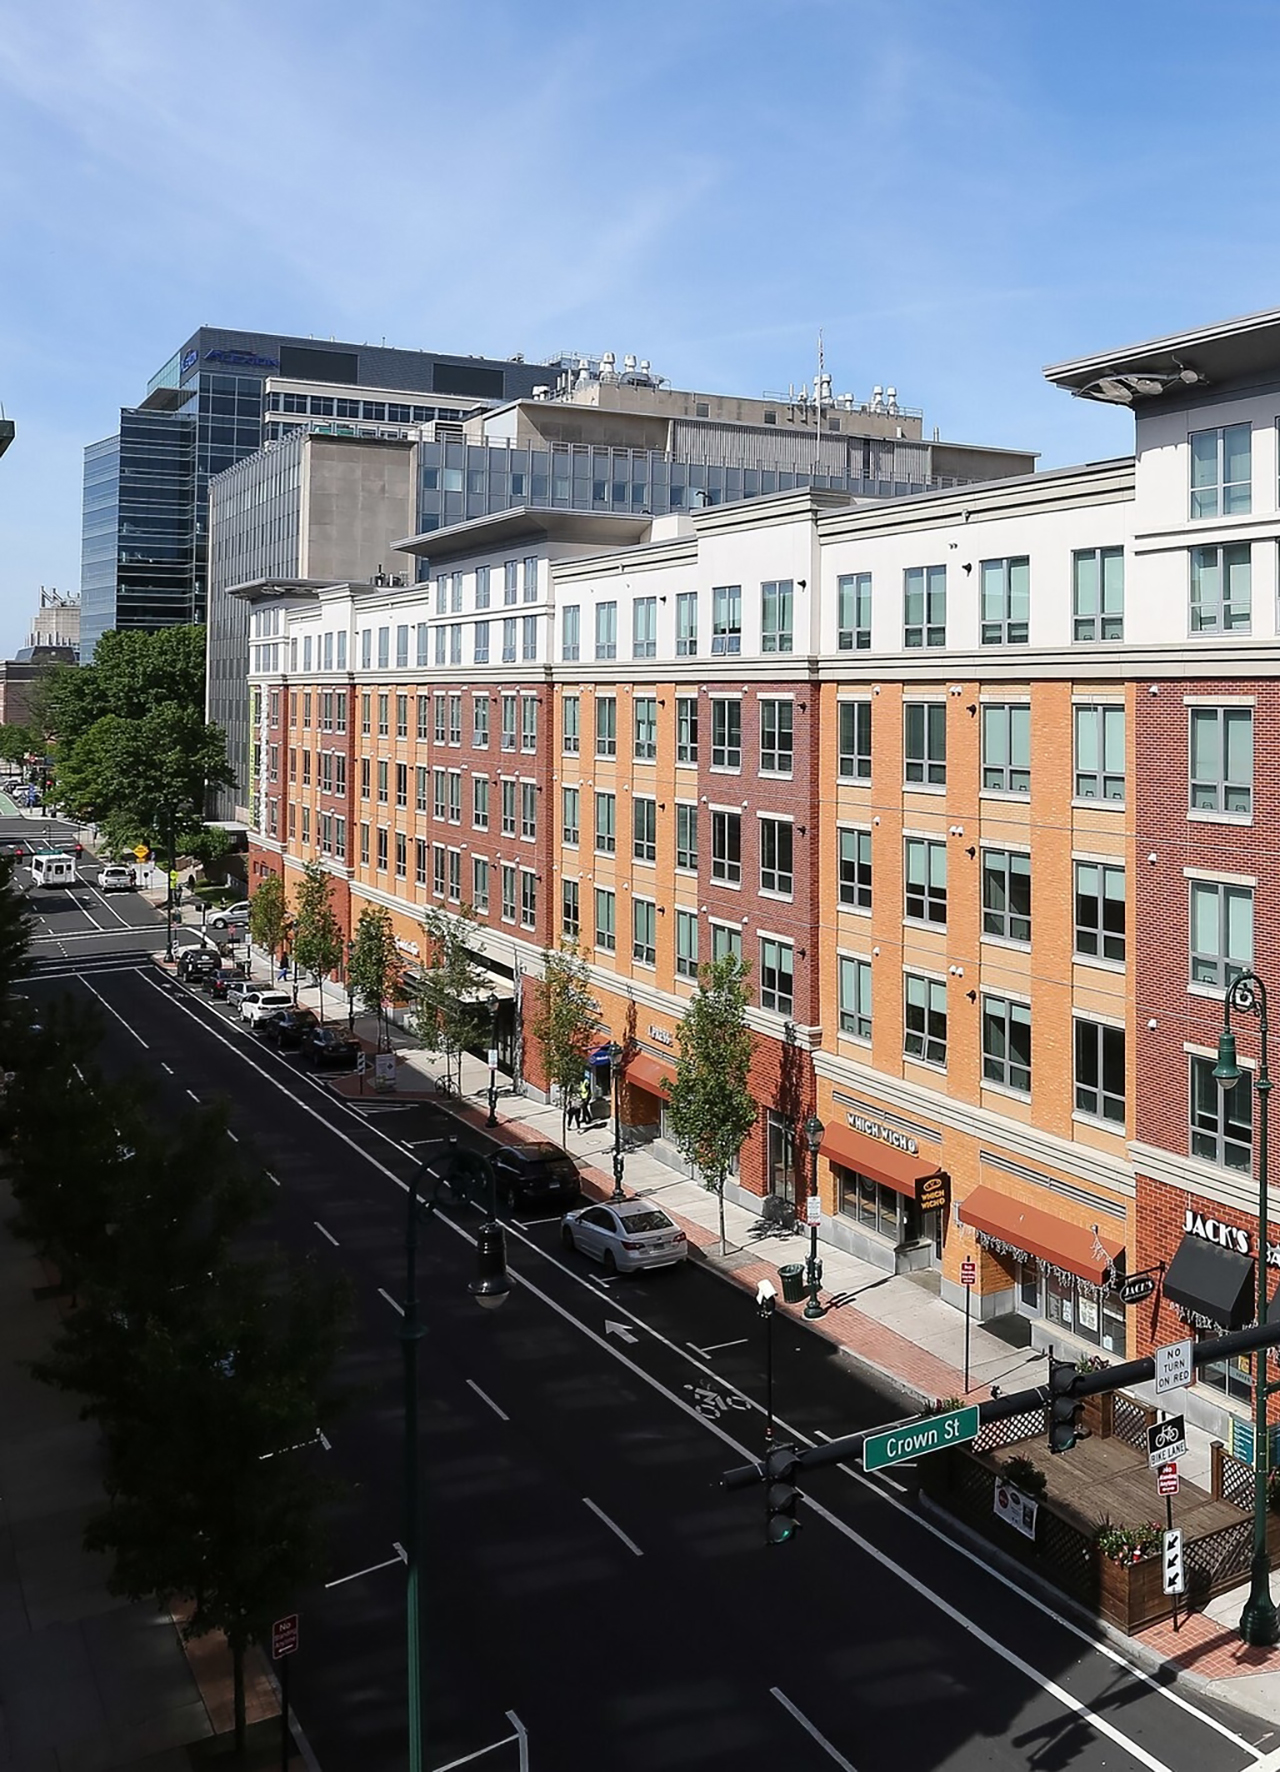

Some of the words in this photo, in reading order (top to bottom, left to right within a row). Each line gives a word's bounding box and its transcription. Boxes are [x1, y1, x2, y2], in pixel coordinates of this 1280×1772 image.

[847, 1113, 879, 1138] WHICH
[921, 1189, 945, 1201] WHICH
[1182, 1210, 1249, 1254] JACK'S
[1124, 1280, 1154, 1297] JACK'S
[1167, 1347, 1181, 1360] NO
[1163, 1360, 1185, 1374] TURN
[1158, 1376, 1170, 1388] ON
[1173, 1370, 1190, 1383] RED
[887, 1429, 938, 1458] Crown
[944, 1418, 960, 1440] St
[1150, 1450, 1167, 1465] BIKE
[1167, 1442, 1185, 1458] LANE
